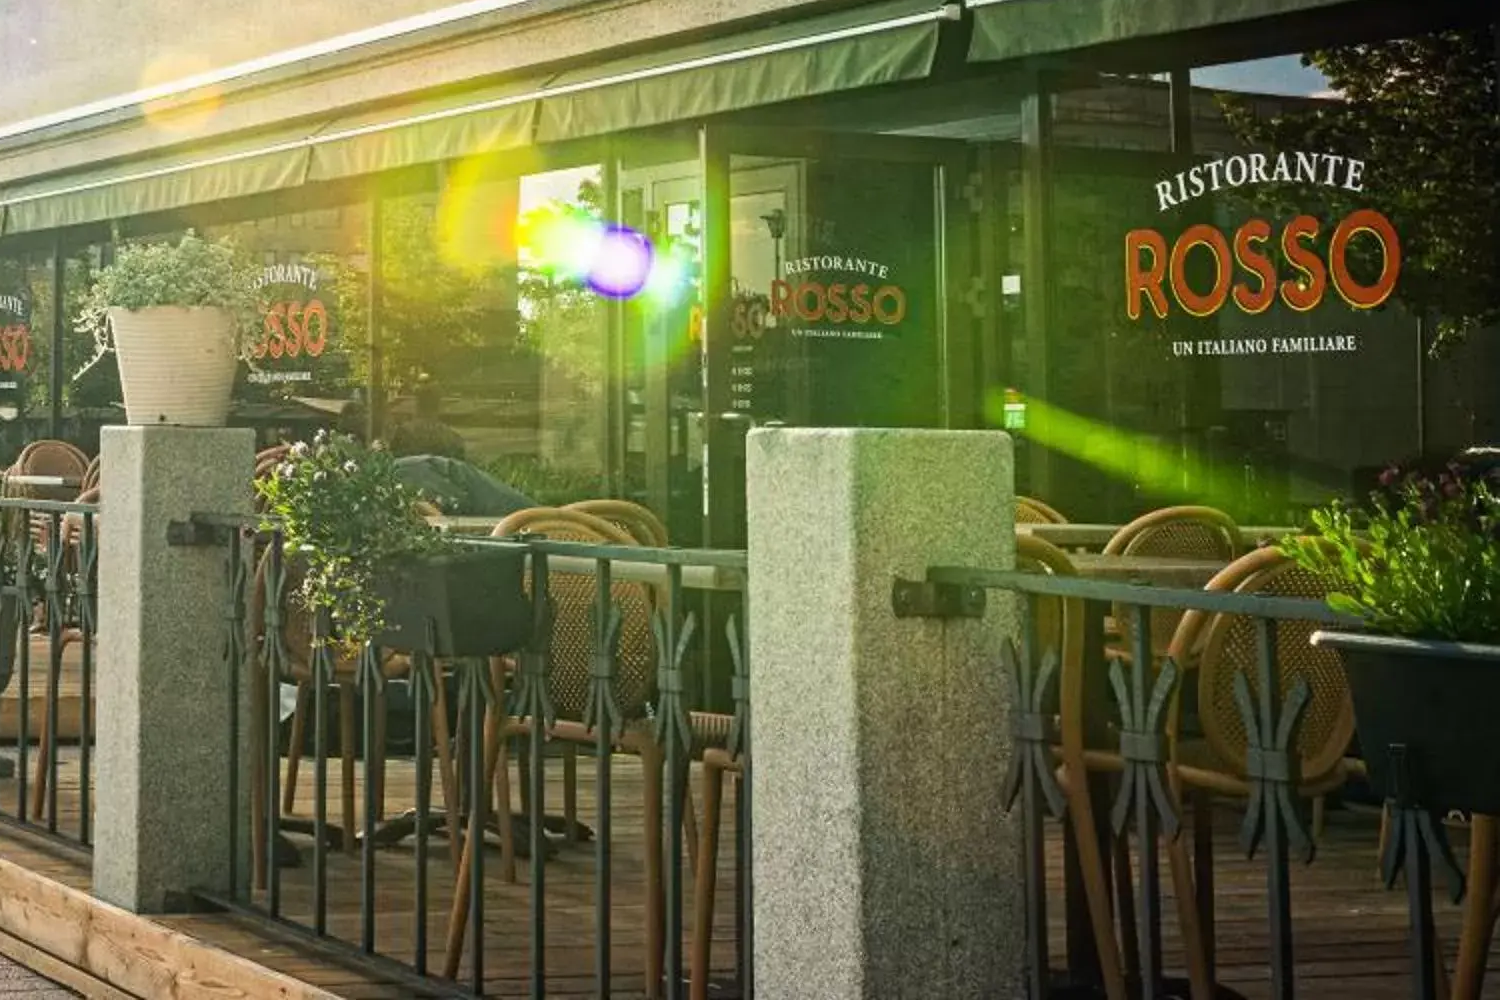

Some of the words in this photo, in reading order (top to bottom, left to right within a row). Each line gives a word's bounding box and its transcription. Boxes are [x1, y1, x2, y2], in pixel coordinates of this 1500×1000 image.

[1154, 151, 1366, 213] RISTORANTE
[784, 255, 889, 280] RISTORANTE
[1124, 208, 1401, 321] ROSSO
[771, 279, 909, 326] ROSSO
[1172, 341, 1194, 357] UN
[1197, 337, 1268, 356] ITALIANO
[1271, 334, 1357, 354] FAMILIARE
